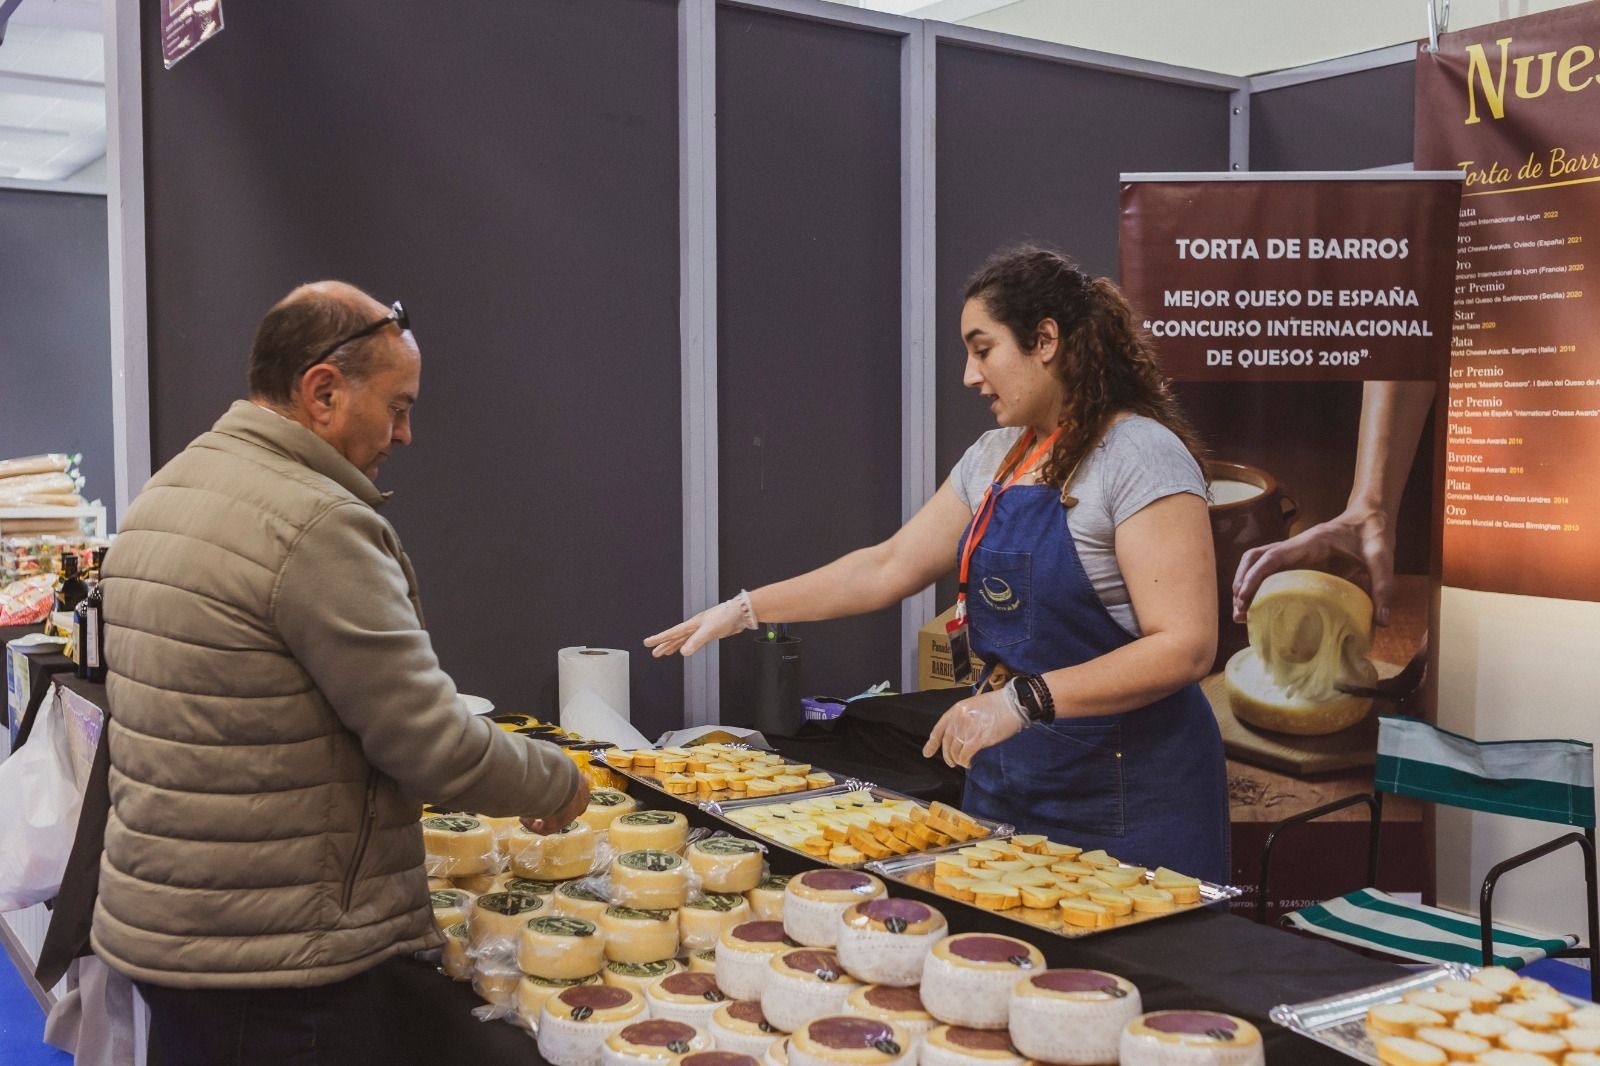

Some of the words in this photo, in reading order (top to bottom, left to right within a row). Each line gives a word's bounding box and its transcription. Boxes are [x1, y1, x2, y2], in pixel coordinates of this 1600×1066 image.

[1465, 37, 1600, 125] Nue
[1457, 161, 1512, 187] Torta
[1518, 152, 1543, 180] de
[1459, 208, 1476, 218] lata
[1478, 216, 1516, 224] Internacional
[1526, 214, 1541, 222] Lyon
[1543, 210, 1559, 219] 2022
[1457, 236, 1472, 244] ro
[1536, 238, 1564, 248] (España)
[1568, 236, 1582, 244] 2021
[1175, 238, 1260, 259] TORTA
[1266, 238, 1301, 259] DE
[1308, 238, 1409, 259] BARROS
[1478, 269, 1512, 278] Internacional
[1522, 268, 1538, 276] Lyon
[1538, 265, 1568, 274] (Francia)
[1568, 264, 1584, 272] 2020
[1455, 286, 1466, 294] er
[1470, 280, 1504, 293] Premio
[1164, 290, 1230, 309] MEJOR
[1235, 290, 1302, 309] QUESO
[1307, 290, 1333, 307] DE
[1338, 286, 1419, 307] ESPAÑA
[1540, 292, 1564, 300] (Sevilla)
[1566, 290, 1583, 298] 2020
[1454, 310, 1476, 320] Star
[1142, 319, 1262, 337] “CONCURSO
[1267, 319, 1433, 337] INTERNACIONAL
[1538, 346, 1557, 354] (Italia)
[1206, 349, 1233, 366] DE
[1237, 349, 1314, 368] QUESOS
[1318, 348, 1369, 367] 2018”
[1467, 364, 1504, 377] Premio
[1564, 379, 1585, 387] Queso
[1586, 378, 1594, 386] de
[1466, 396, 1502, 408] Premio
[1490, 409, 1513, 418] España
[1448, 424, 1472, 435] Plata
[1486, 437, 1508, 445] Awards
[1448, 452, 1484, 464] Bronce
[1486, 466, 1506, 474] Awards
[1447, 478, 1471, 490] Plata
[1473, 493, 1494, 501] Mundial
[1504, 494, 1526, 502] Quesos
[1526, 496, 1551, 504] Londres
[1553, 496, 1568, 504] 2014
[1446, 504, 1466, 516] Oro
[1446, 517, 1472, 526] Concurso
[1472, 518, 1494, 527] Mundial
[1502, 520, 1524, 528] Quesos
[1526, 522, 1561, 532] Birmingham
[1563, 523, 1580, 532] 2013
